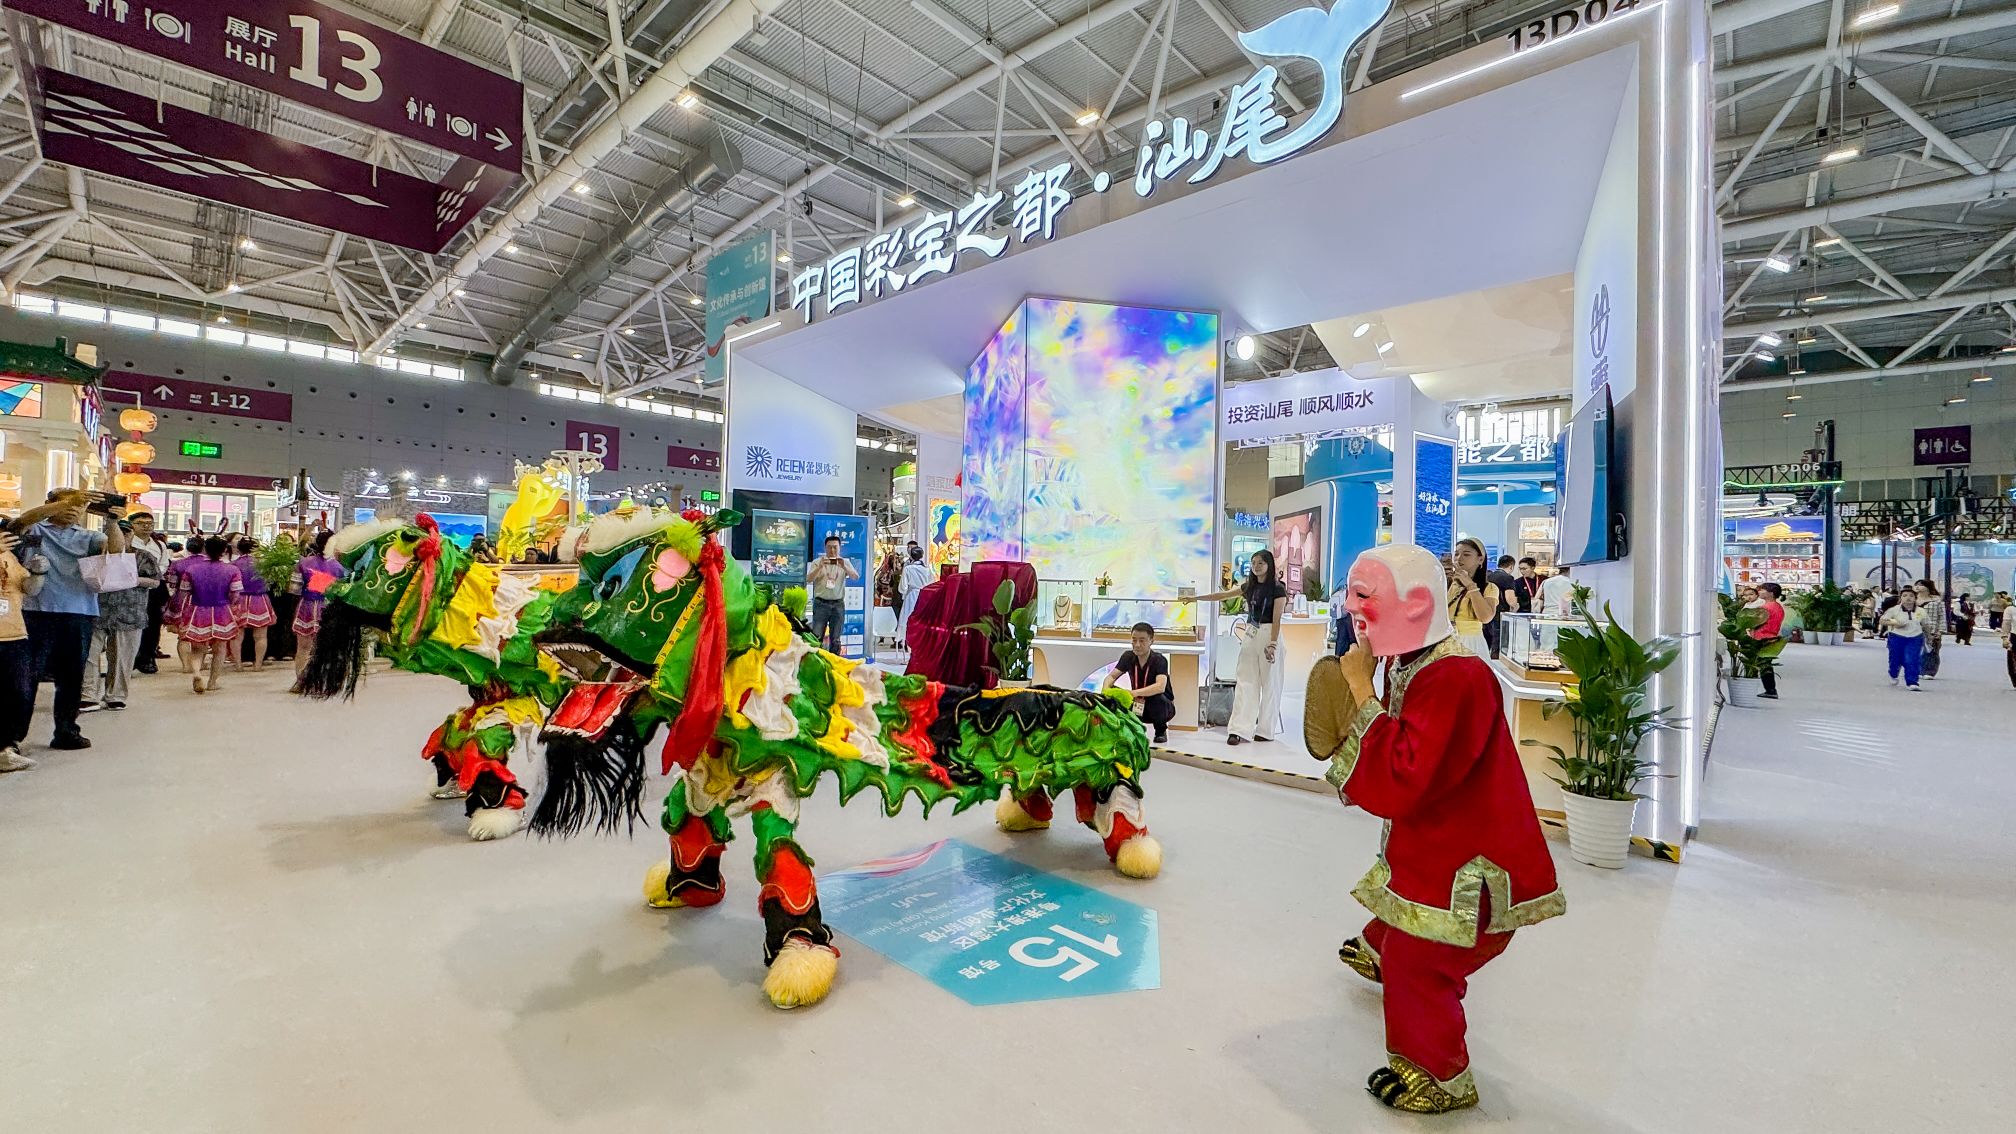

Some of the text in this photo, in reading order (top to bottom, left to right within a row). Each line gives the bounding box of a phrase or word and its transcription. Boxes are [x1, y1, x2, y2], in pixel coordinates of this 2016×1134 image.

[225, 15, 277, 48] 展厅
[225, 40, 275, 74] Hall
[288, 14, 383, 103] 13
[752, 241, 767, 265] 13
[210, 391, 251, 410] 1-12
[1228, 389, 1374, 425] 投资汕尾 顺风顺水
[578, 432, 608, 459] 13
[199, 474, 218, 486] 14
[776, 458, 840, 477] REIEN 蕾恩珠宝
[1771, 463, 1820, 474] 13D06
[918, 888, 1047, 943] 文化产业创新馆
[949, 902, 1061, 950] 粤港澳大湾区
[958, 924, 1122, 982] 15 号馆
